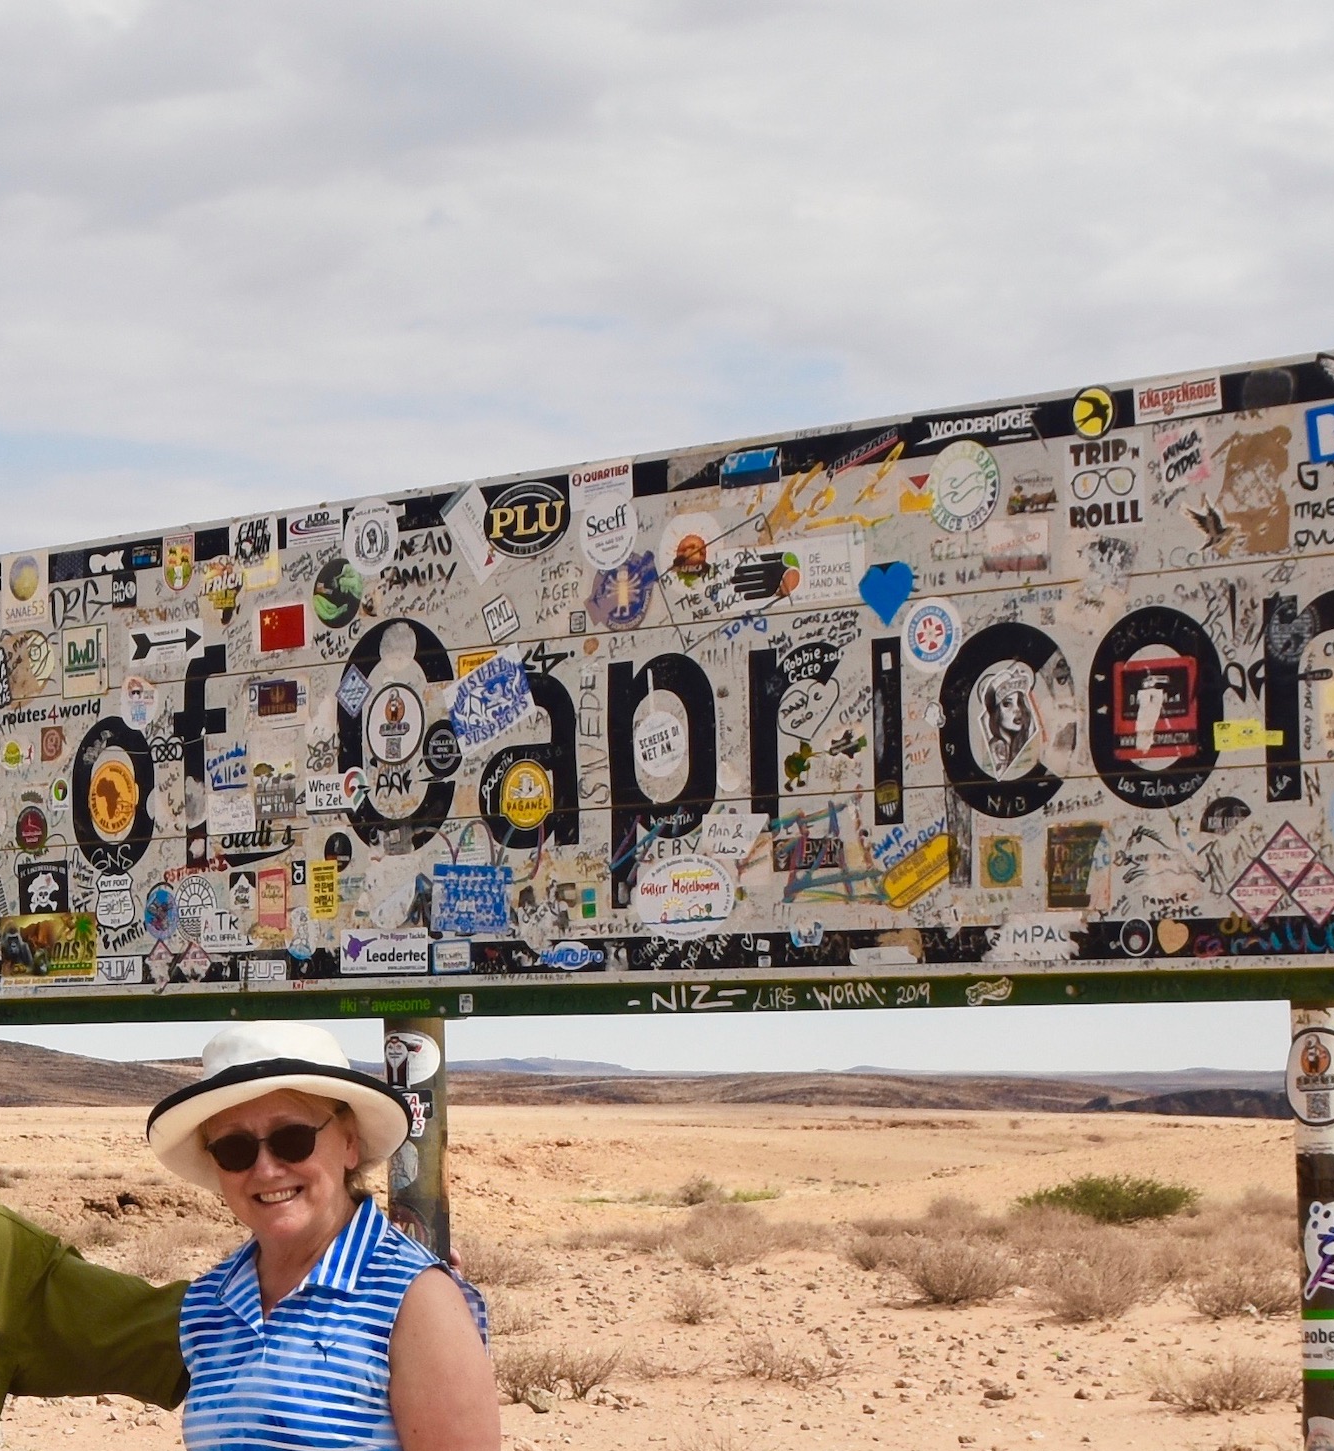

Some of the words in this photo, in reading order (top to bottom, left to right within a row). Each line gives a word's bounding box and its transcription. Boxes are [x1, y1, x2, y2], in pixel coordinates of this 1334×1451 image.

[929, 409, 1033, 437] WOODBRIDGE
[1070, 438, 1127, 467] TRIP
[583, 465, 629, 484] QUARTIER
[305, 512, 329, 522] JUDD
[489, 501, 566, 539] PLU
[586, 504, 627, 537] Seeff
[1069, 500, 1143, 529] ROLLL
[809, 554, 821, 564] DE
[809, 562, 851, 577] STRAKKE
[464, 699, 529, 746] SUSPECTS
[73, 644, 227, 874] of
[307, 779, 340, 793] Where
[315, 794, 324, 807] Is
[325, 793, 344, 807] Zet
[366, 948, 427, 964] Leadertec
[540, 948, 604, 967] HydroPro
[896, 983, 930, 1006] 2019
[372, 997, 430, 1012] awesome
